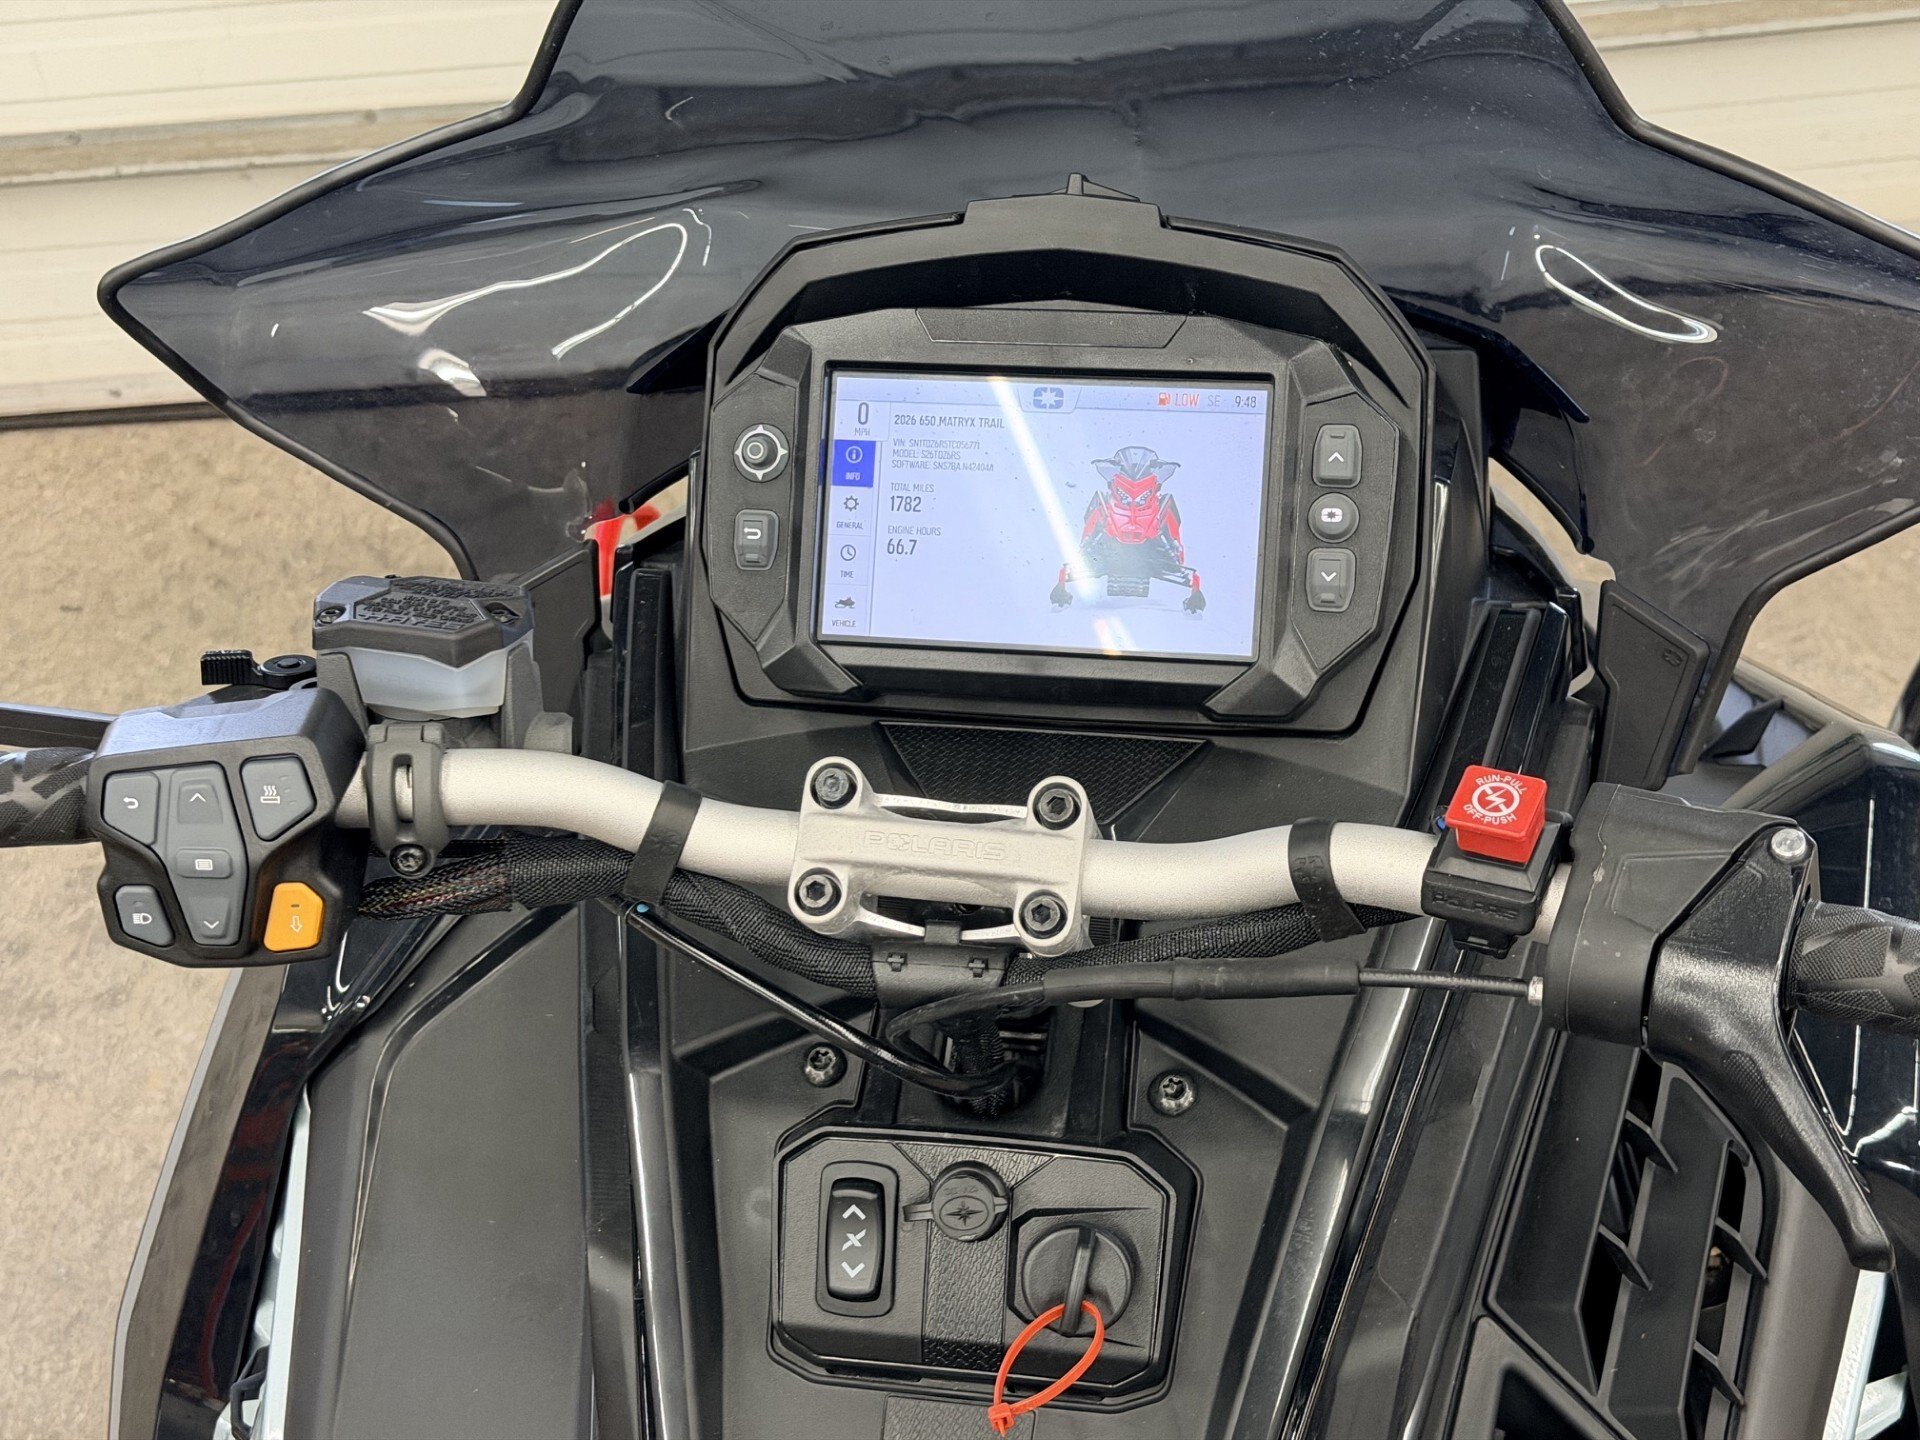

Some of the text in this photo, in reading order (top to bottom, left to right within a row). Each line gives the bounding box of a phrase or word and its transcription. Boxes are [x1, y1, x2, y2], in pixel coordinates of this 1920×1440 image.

[1175, 393, 1200, 407] LOW
[1207, 395, 1221, 407] SE
[1235, 395, 1257, 409] 9:48
[857, 402, 869, 425] 0
[894, 414, 1005, 429] 2026 650 MATRYX TRAIL
[854, 427, 871, 437] MPH
[845, 472, 861, 481] INFO
[890, 482, 935, 493] TOTAL MILES
[890, 496, 922, 513] 1782
[836, 521, 863, 530] GENERAL
[887, 525, 942, 537] ENGINE HOURS
[886, 538, 918, 556] 66.7
[840, 570, 854, 579] TIME
[831, 619, 856, 628] VEHICLE
[1475, 774, 1528, 795] RUN-PULL
[1463, 803, 1518, 826] OFF-PUSH
[863, 830, 1007, 862] POLARIS
